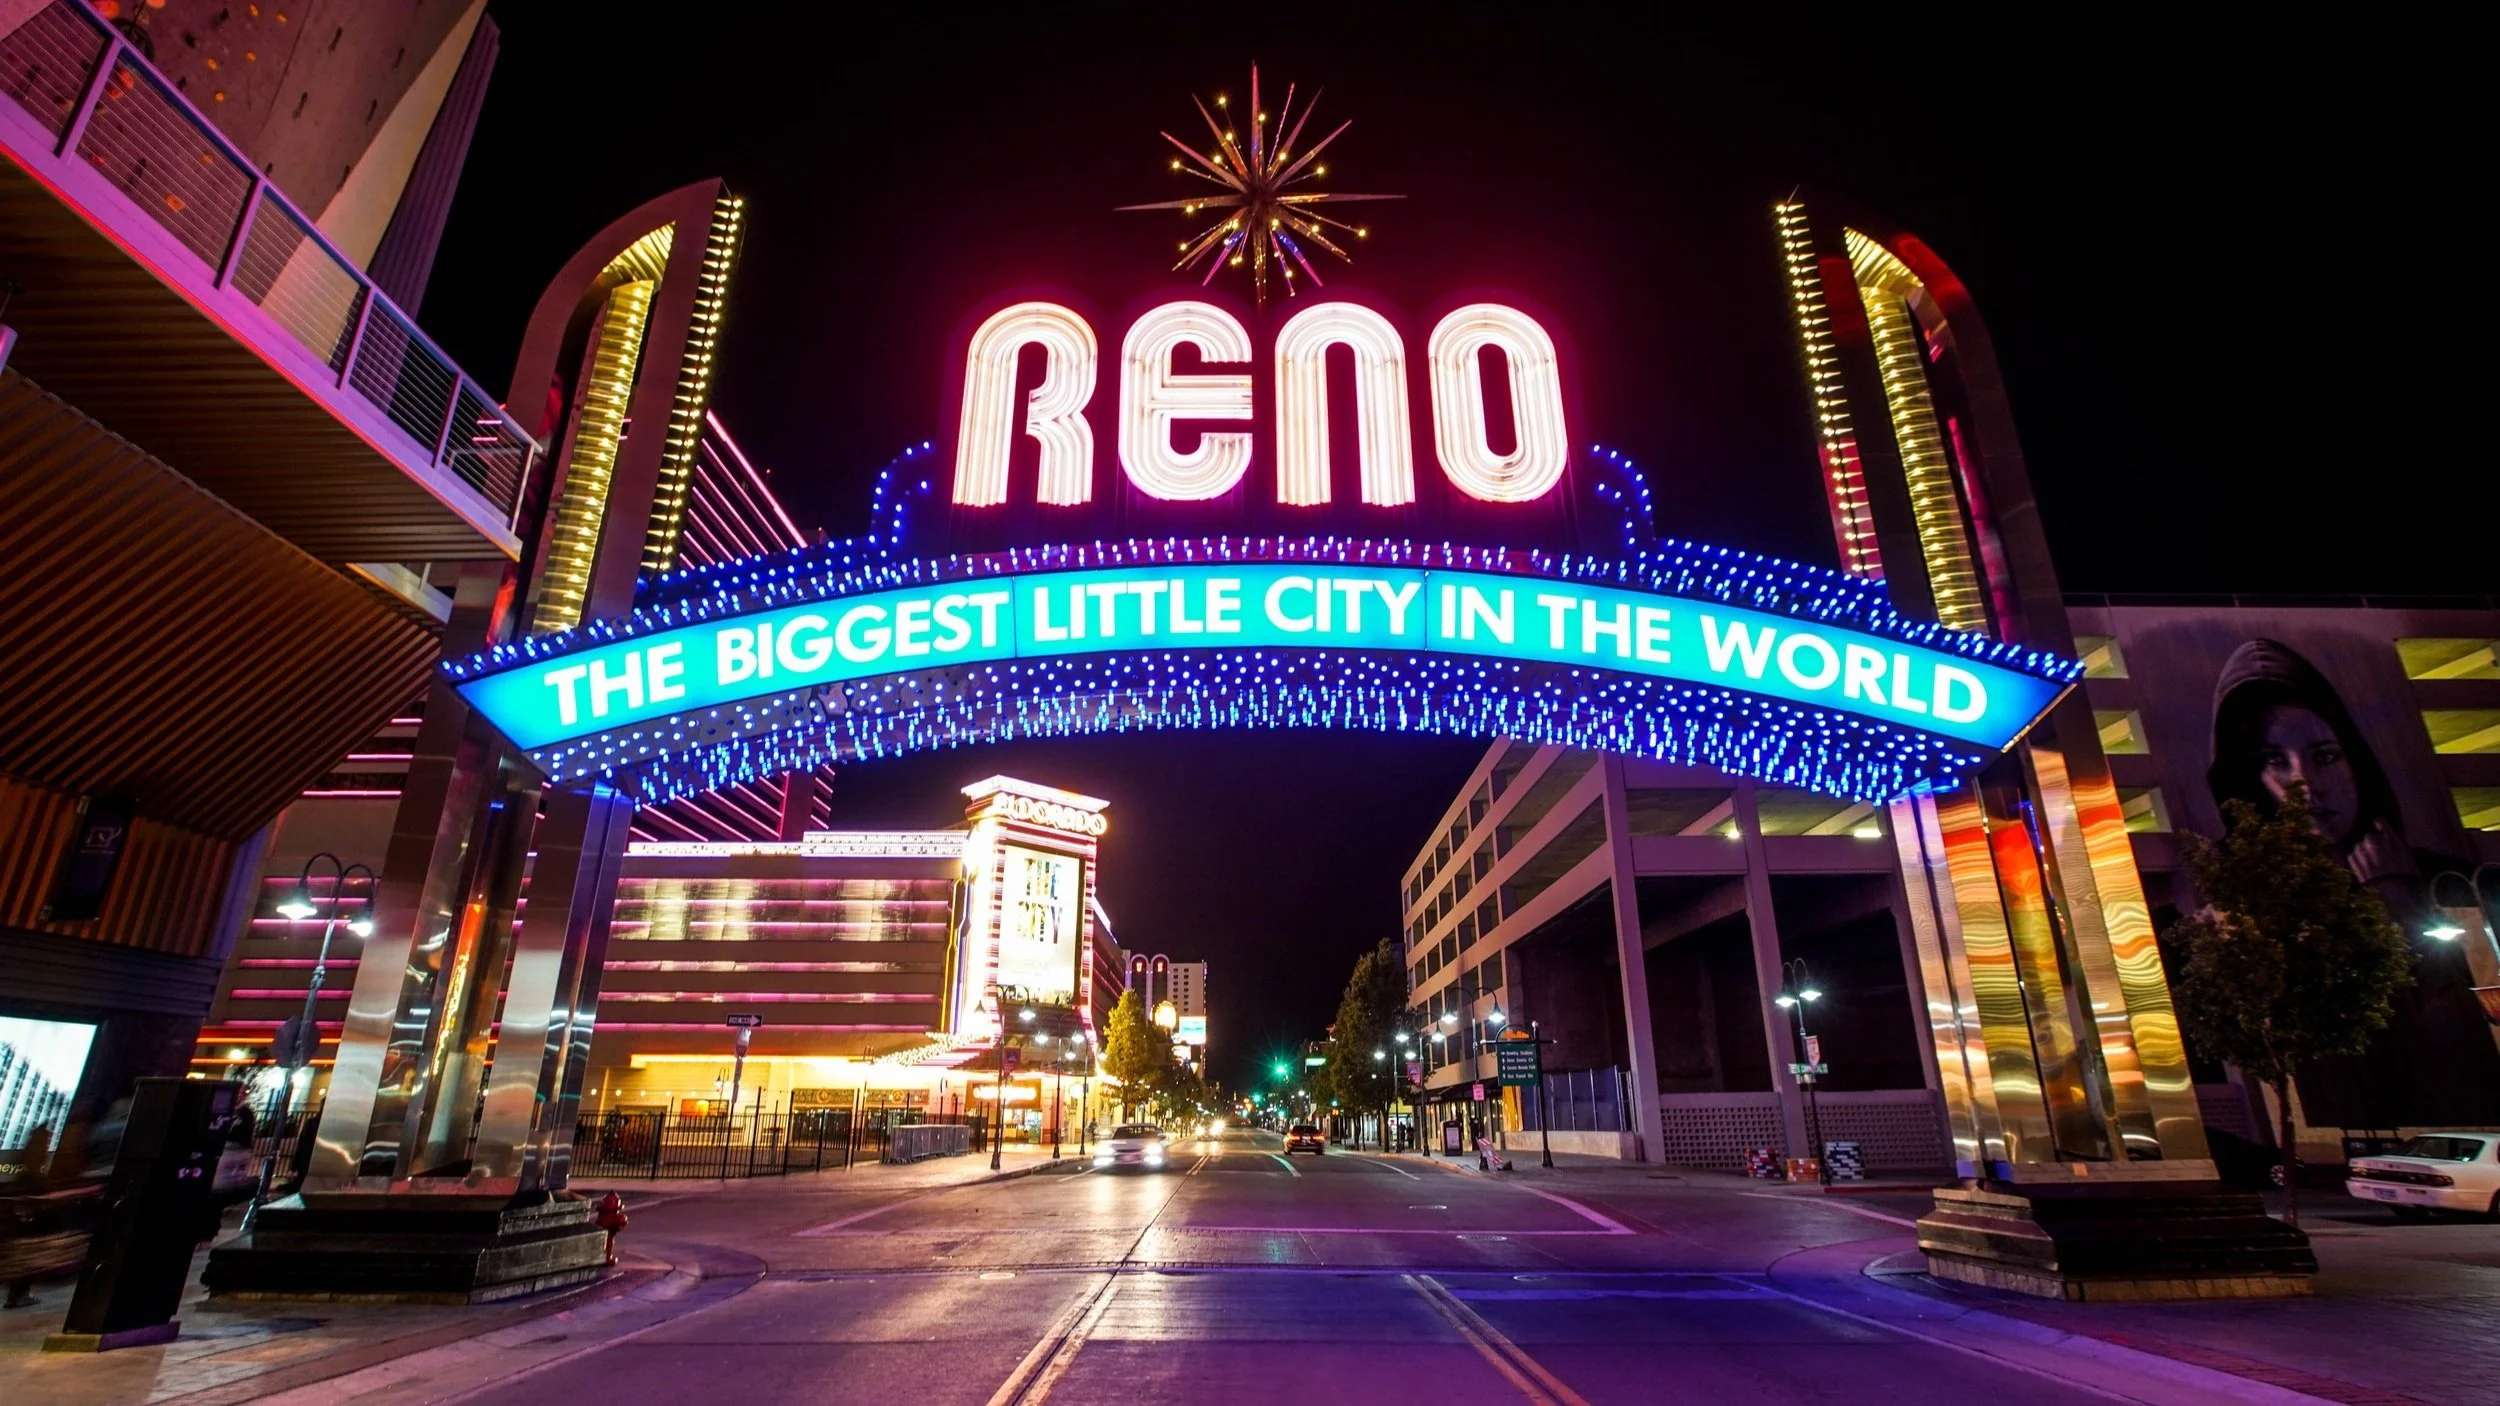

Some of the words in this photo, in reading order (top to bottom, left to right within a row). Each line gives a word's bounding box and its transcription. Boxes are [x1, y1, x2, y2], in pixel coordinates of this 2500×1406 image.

[952, 301, 1568, 507] RENO
[544, 641, 686, 727] THE
[717, 591, 1009, 686] BIGGEST
[1034, 578, 1241, 643] LITTLE
[1264, 576, 1421, 634] CITY
[1441, 584, 1515, 644] IN
[1537, 594, 1671, 664] THE
[1700, 614, 1987, 723] WORLD
